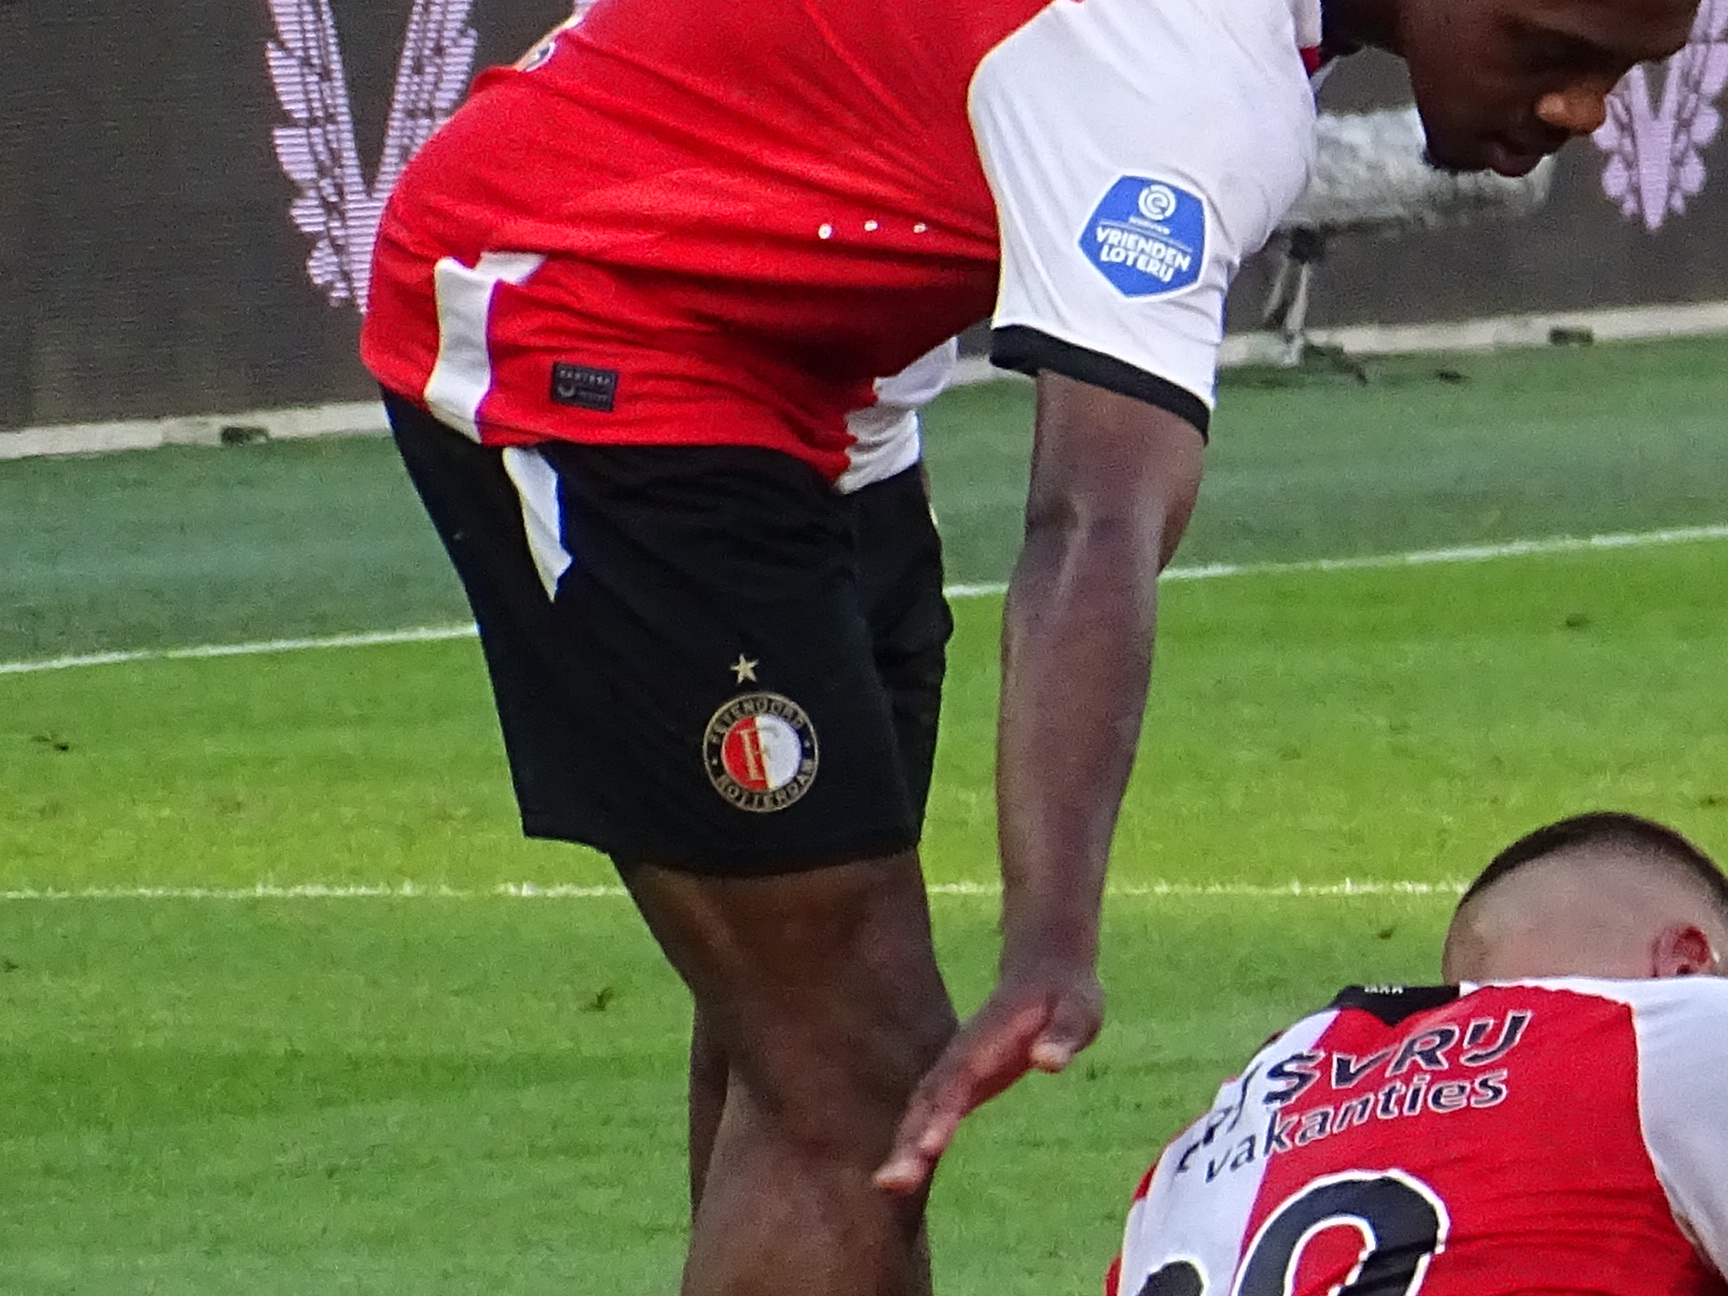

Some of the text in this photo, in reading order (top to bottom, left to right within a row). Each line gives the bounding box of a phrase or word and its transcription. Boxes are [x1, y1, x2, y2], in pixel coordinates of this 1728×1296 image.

[1096, 226, 1191, 272] VRIENDEN
[1100, 245, 1174, 283] LOTERIJ
[1205, 1068, 1509, 1184] vakanties
